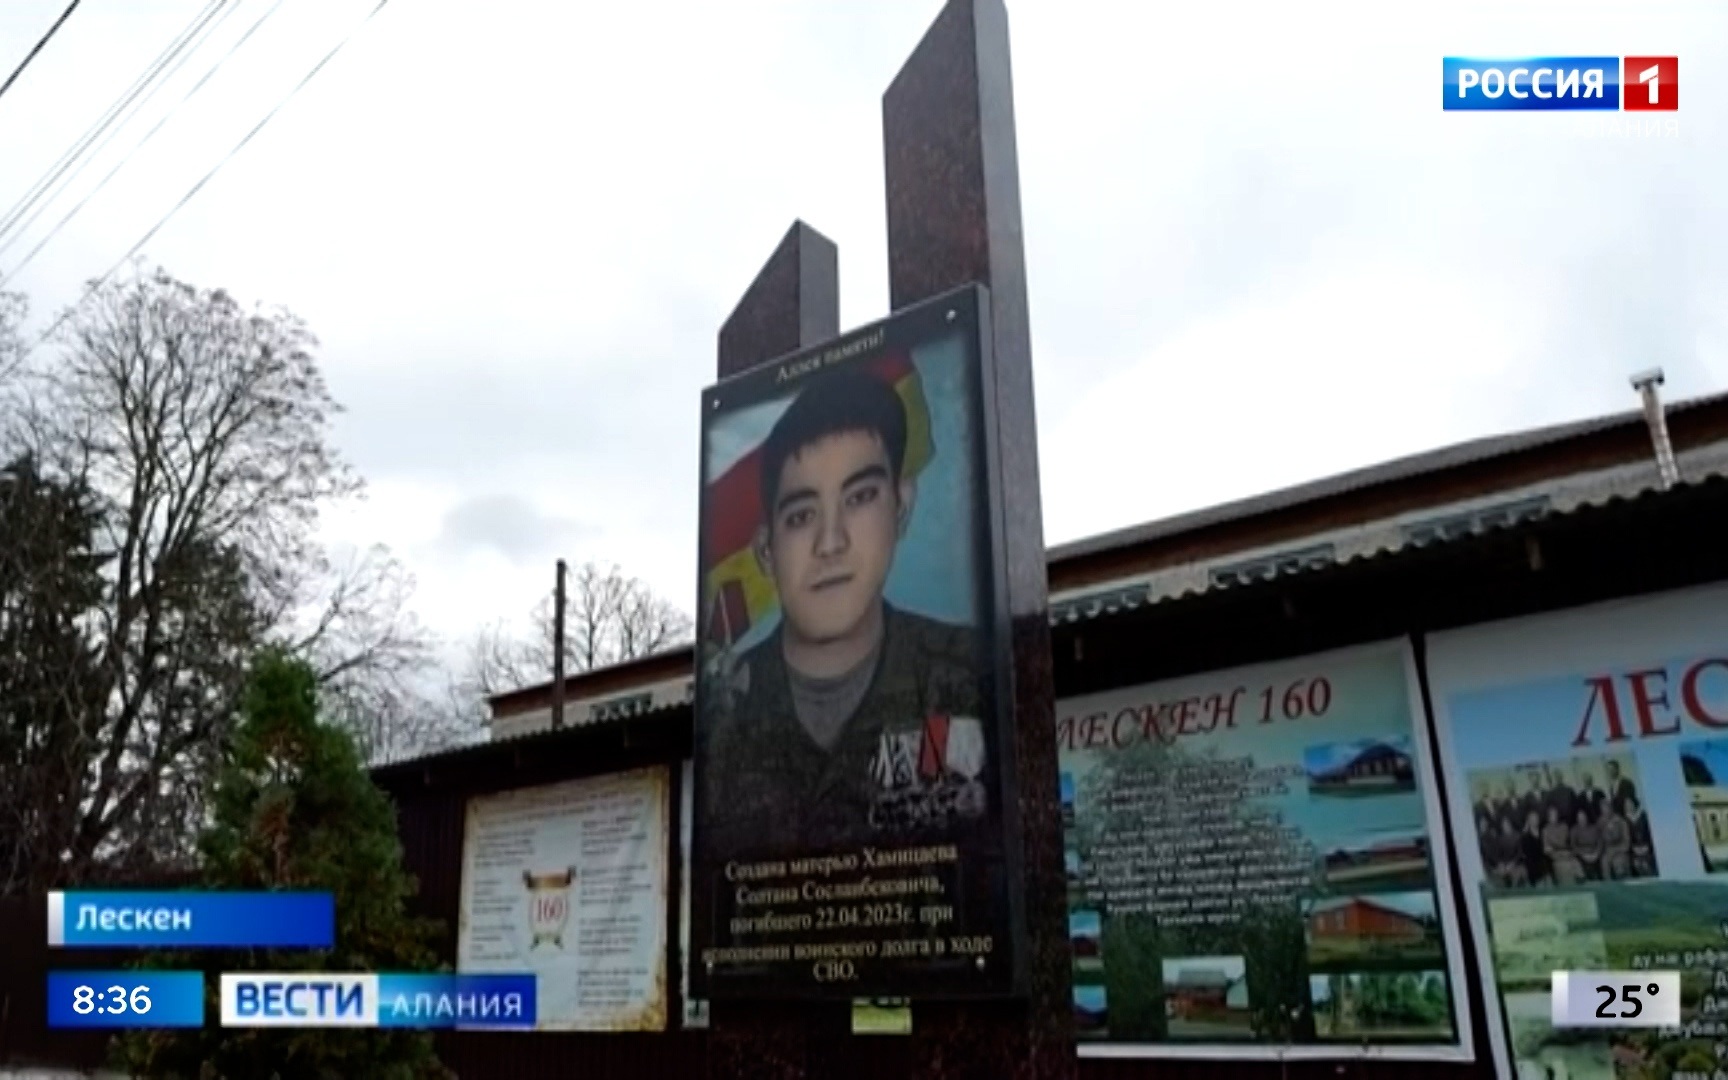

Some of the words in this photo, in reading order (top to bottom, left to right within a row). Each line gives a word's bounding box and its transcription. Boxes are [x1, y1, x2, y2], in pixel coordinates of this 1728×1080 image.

[1056, 685, 1245, 752] ЛЕСКЕН
[1257, 676, 1332, 725] 160
[790, 852, 858, 877] матерью
[729, 910, 812, 935] погибшего
[918, 903, 955, 929] при
[793, 940, 877, 962] воинского
[880, 938, 931, 959] долга
[934, 939, 947, 954] в
[949, 935, 994, 955] ходе
